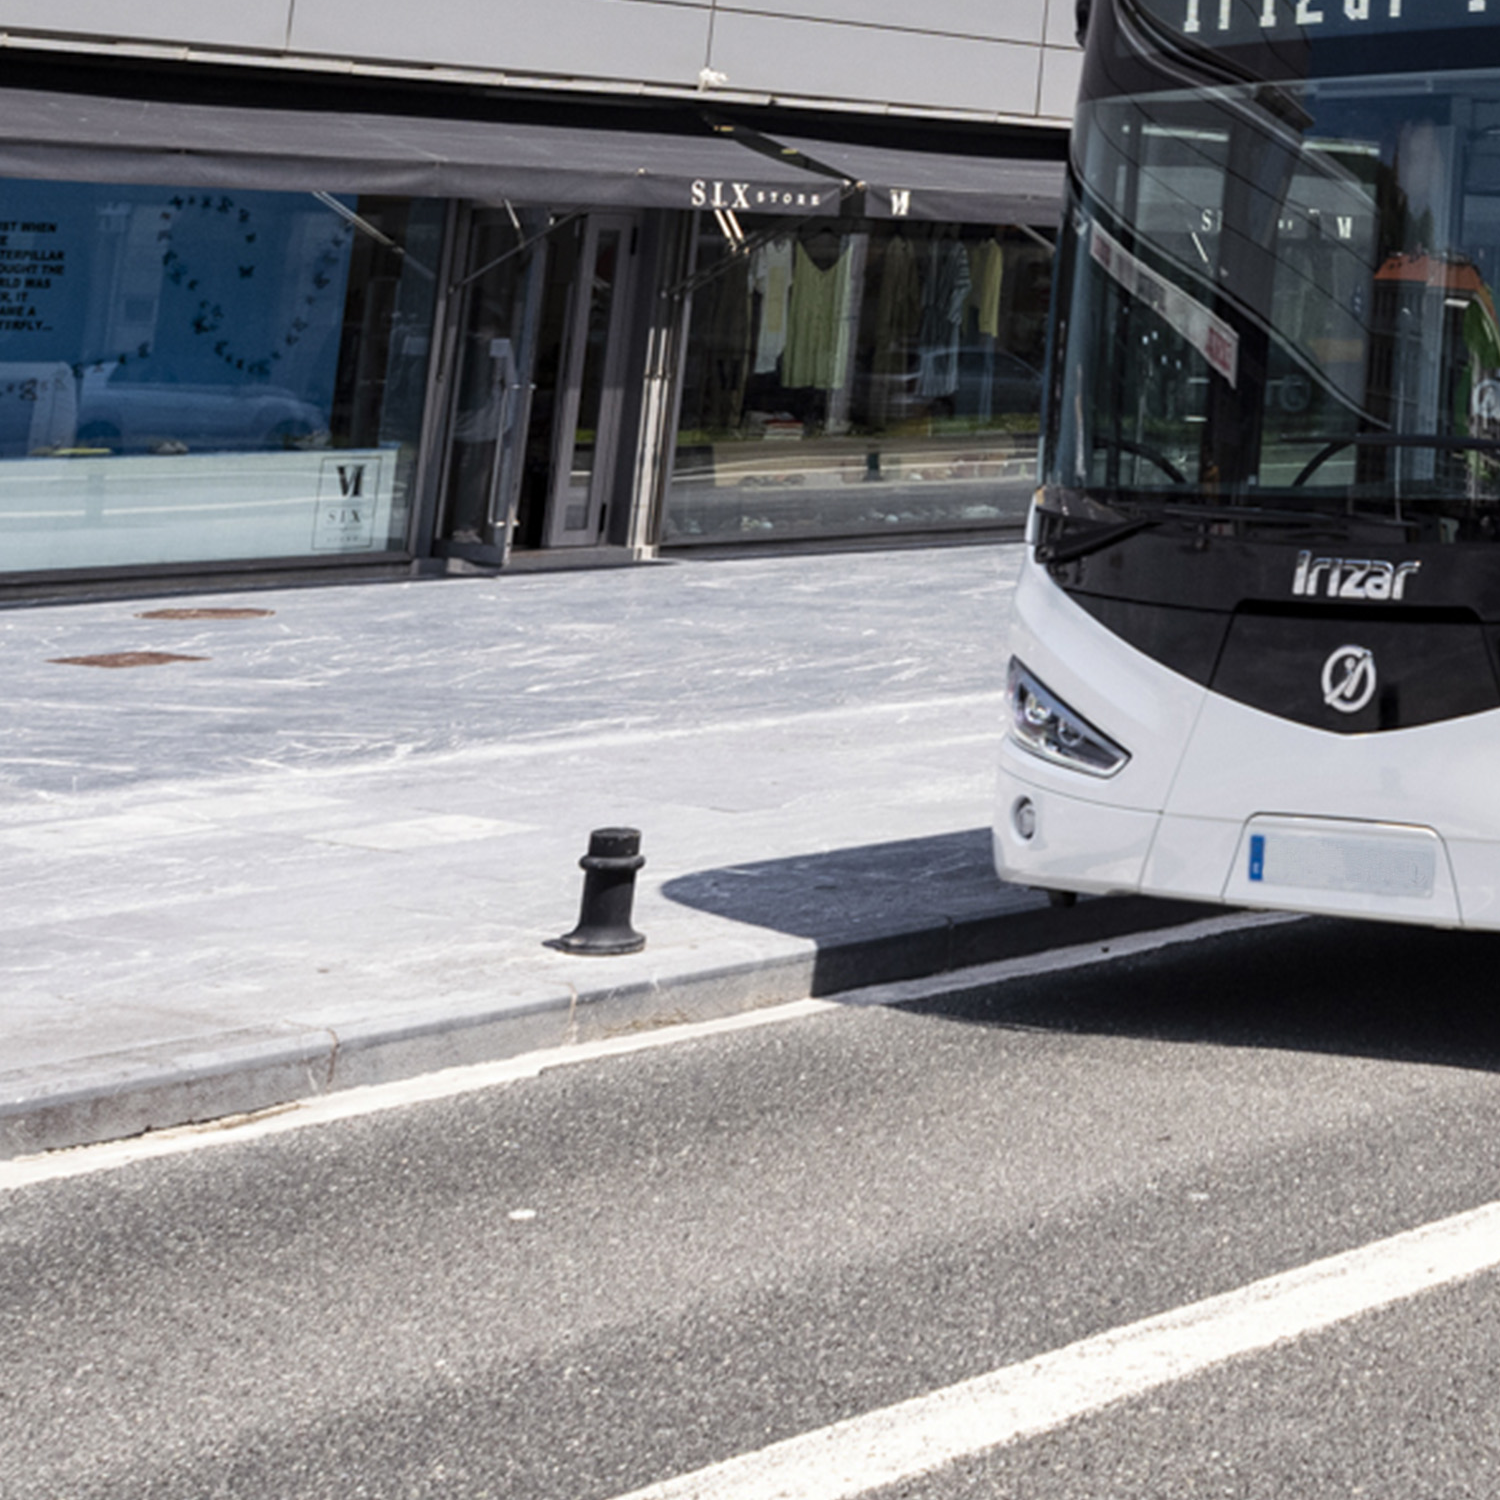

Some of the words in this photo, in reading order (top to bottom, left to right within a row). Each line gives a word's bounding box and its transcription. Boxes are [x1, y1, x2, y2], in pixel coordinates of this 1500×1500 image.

[690, 179, 750, 209] SIX
[756, 191, 820, 206] STORE
[21, 222, 57, 233] WHEN
[42, 265, 65, 276] THE
[25, 279, 51, 289] WAS
[27, 306, 36, 317] A
[1292, 549, 1422, 600] Irizar
